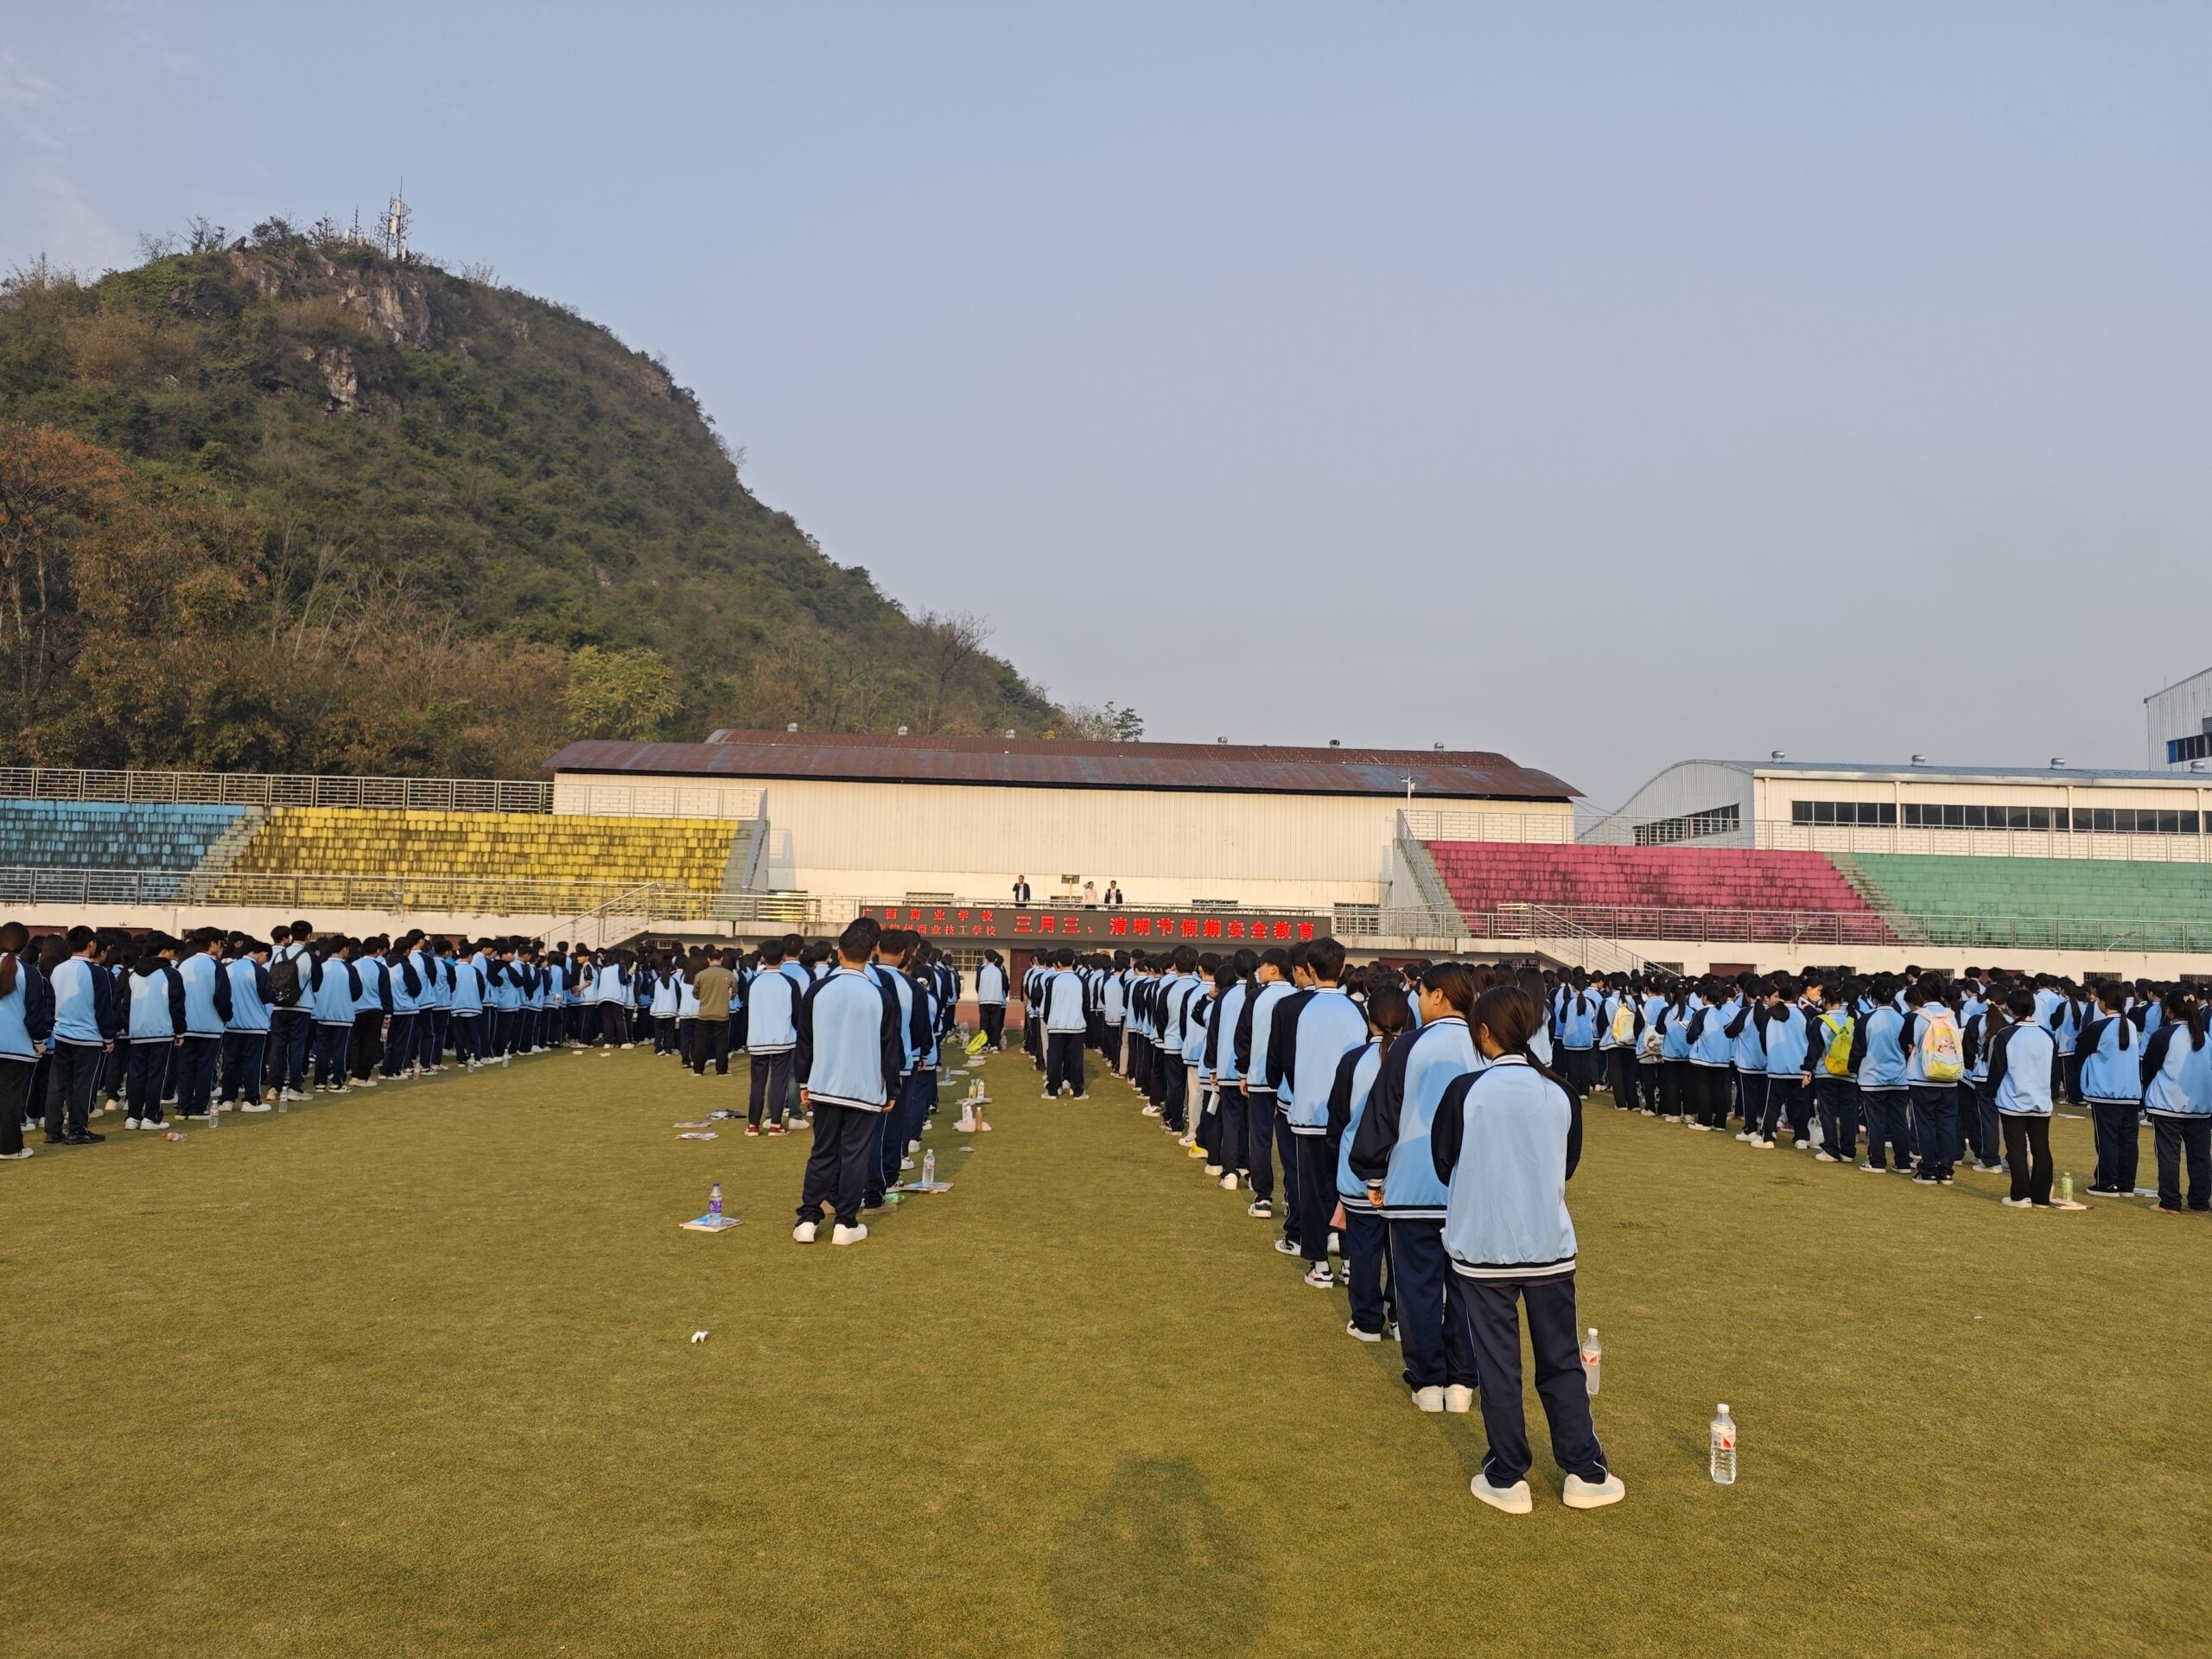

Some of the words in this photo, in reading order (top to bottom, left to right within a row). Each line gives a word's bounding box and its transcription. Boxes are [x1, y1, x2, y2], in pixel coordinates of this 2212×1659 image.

[1014, 915, 1315, 940] 三月三、清明节假期安全教育
